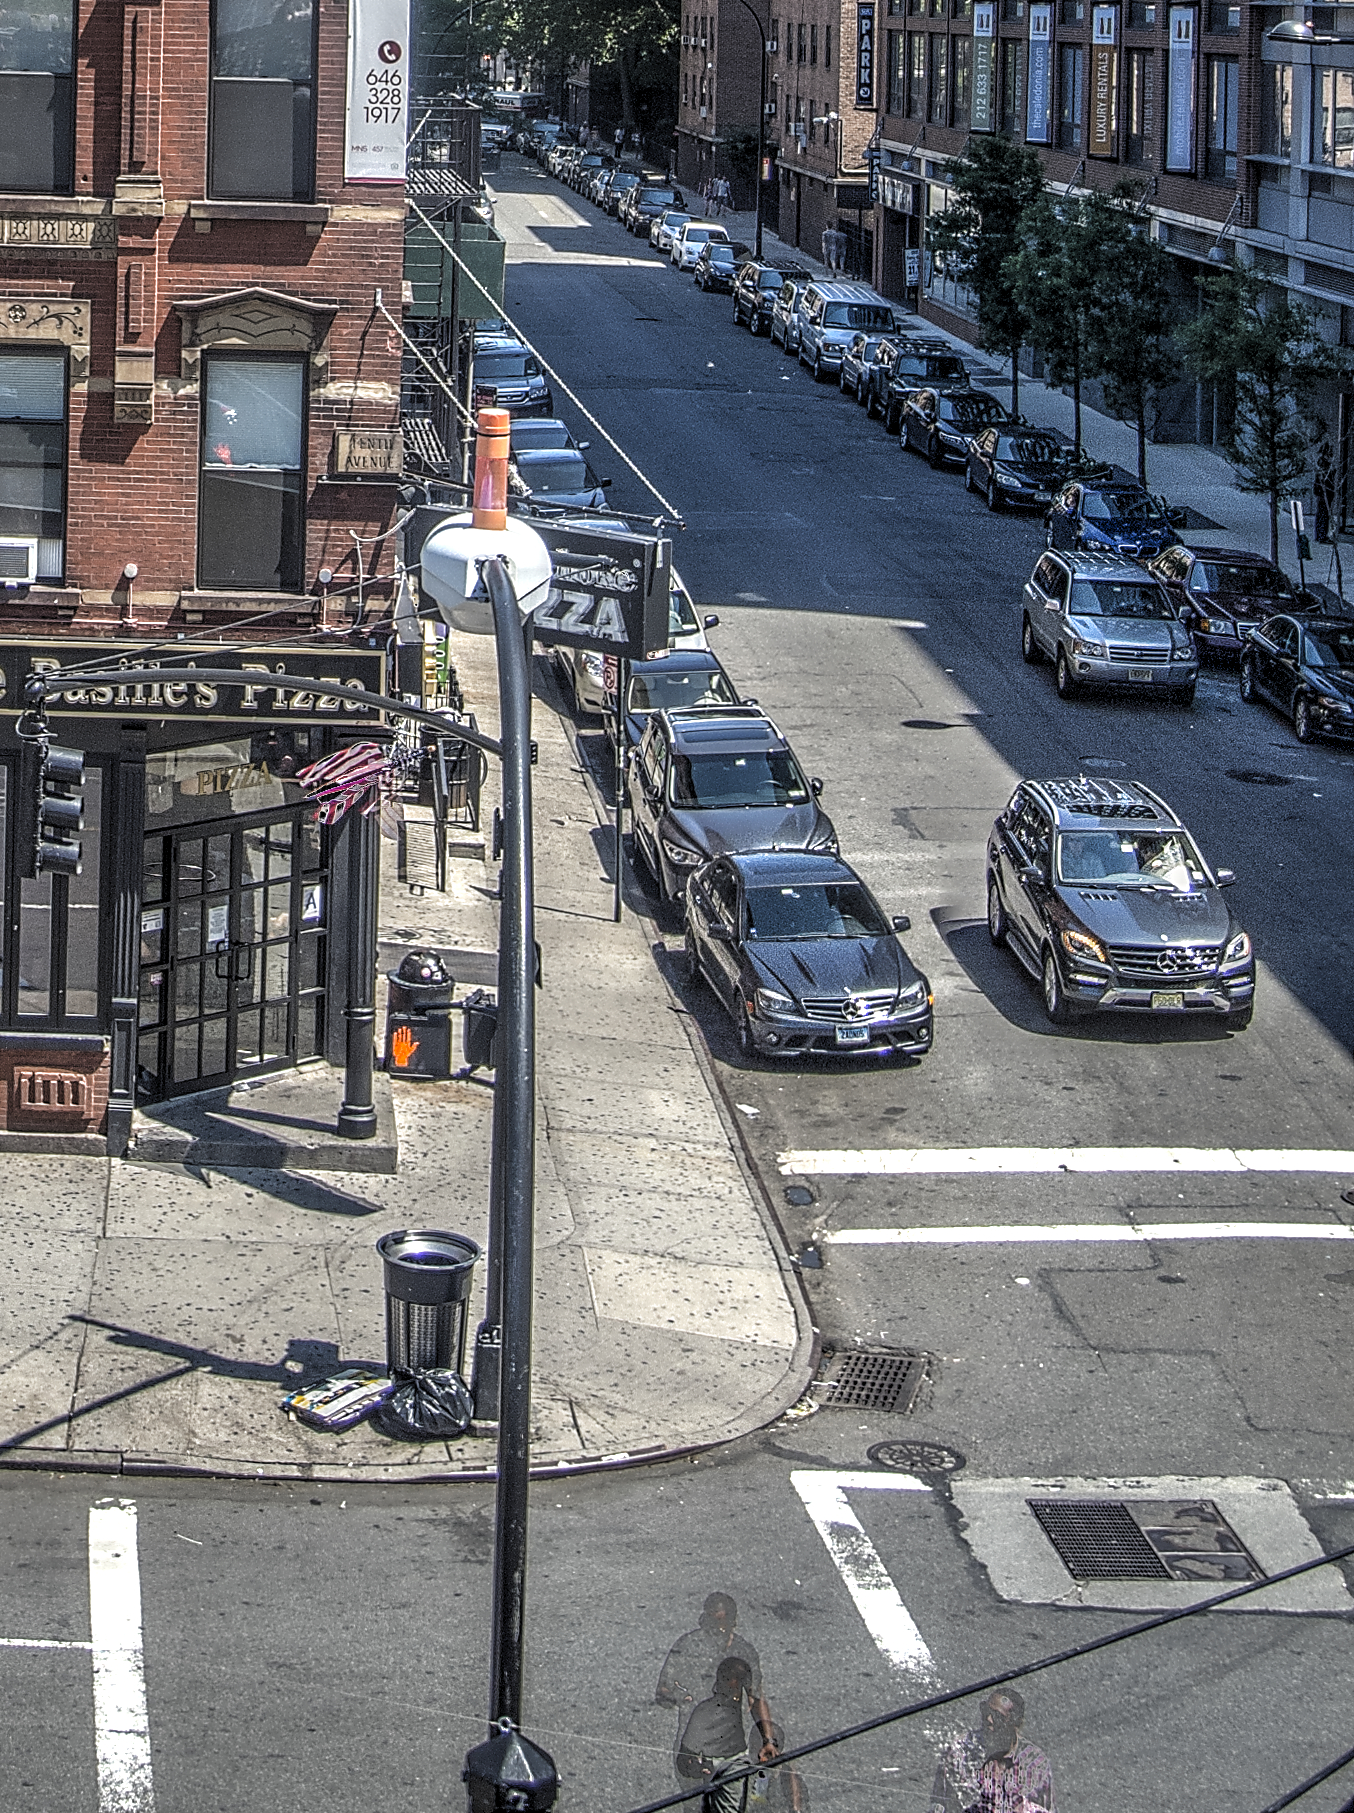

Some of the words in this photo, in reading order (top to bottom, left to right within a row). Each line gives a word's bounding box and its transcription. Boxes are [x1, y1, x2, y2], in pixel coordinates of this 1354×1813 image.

[860, 19, 872, 84] PARK
[977, 43, 988, 70] 1717
[366, 68, 402, 86] 646
[976, 73, 987, 95] 633
[1097, 52, 1109, 98] RENTALS
[367, 87, 402, 105] 328
[1032, 47, 1044, 129] thecaledonia.com
[363, 106, 402, 124] 1917
[975, 97, 987, 120] 212
[1095, 98, 1108, 143] LUXURY
[350, 437, 394, 450] TENTH
[195, 760, 273, 797] PIZZA
[305, 892, 317, 910] A
